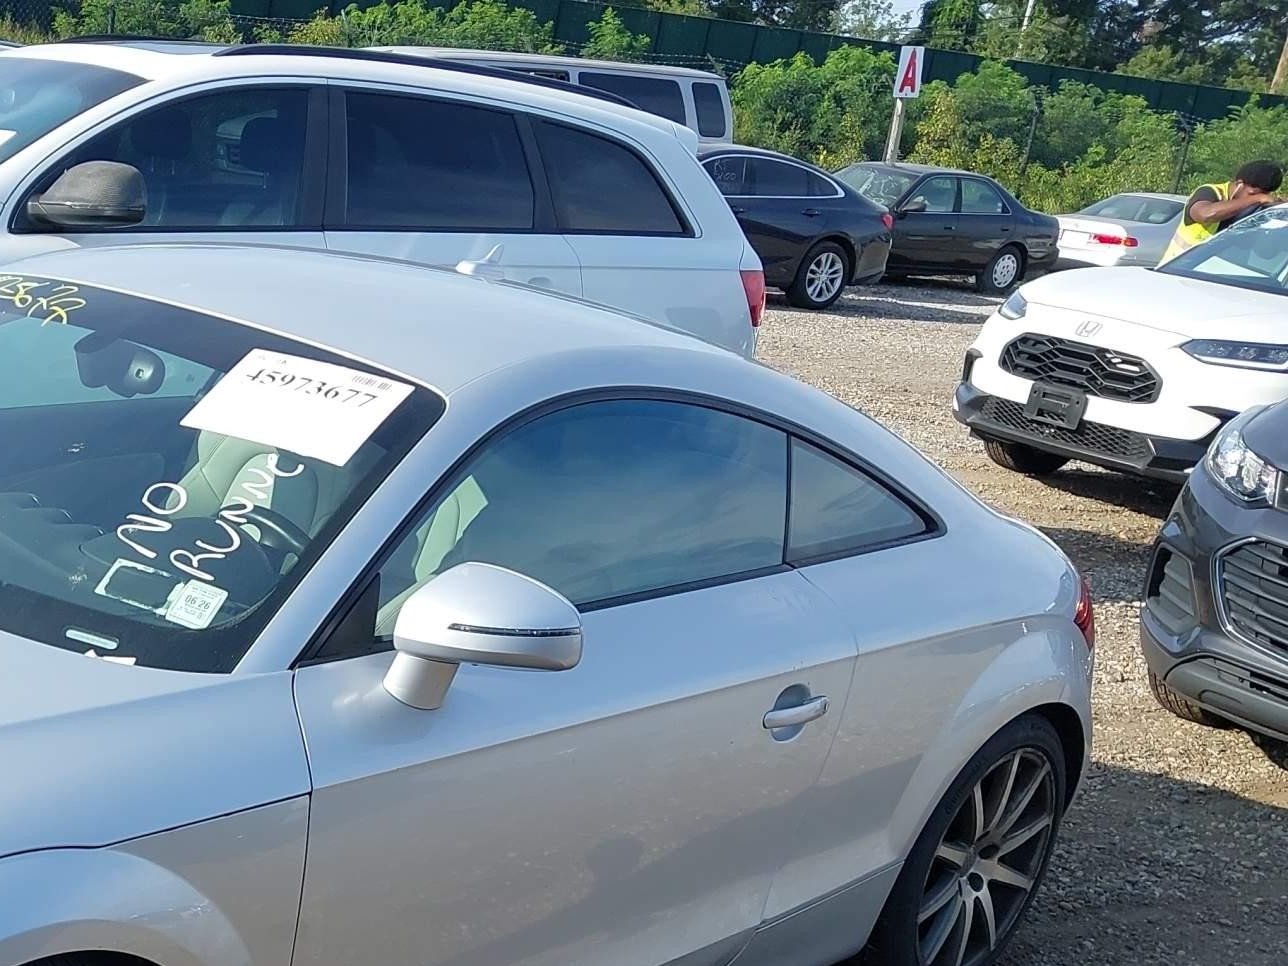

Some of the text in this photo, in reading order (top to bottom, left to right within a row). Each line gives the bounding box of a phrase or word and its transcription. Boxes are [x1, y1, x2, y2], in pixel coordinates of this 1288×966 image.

[899, 48, 917, 93] A
[246, 368, 379, 407] 45973677
[116, 482, 188, 559] NO
